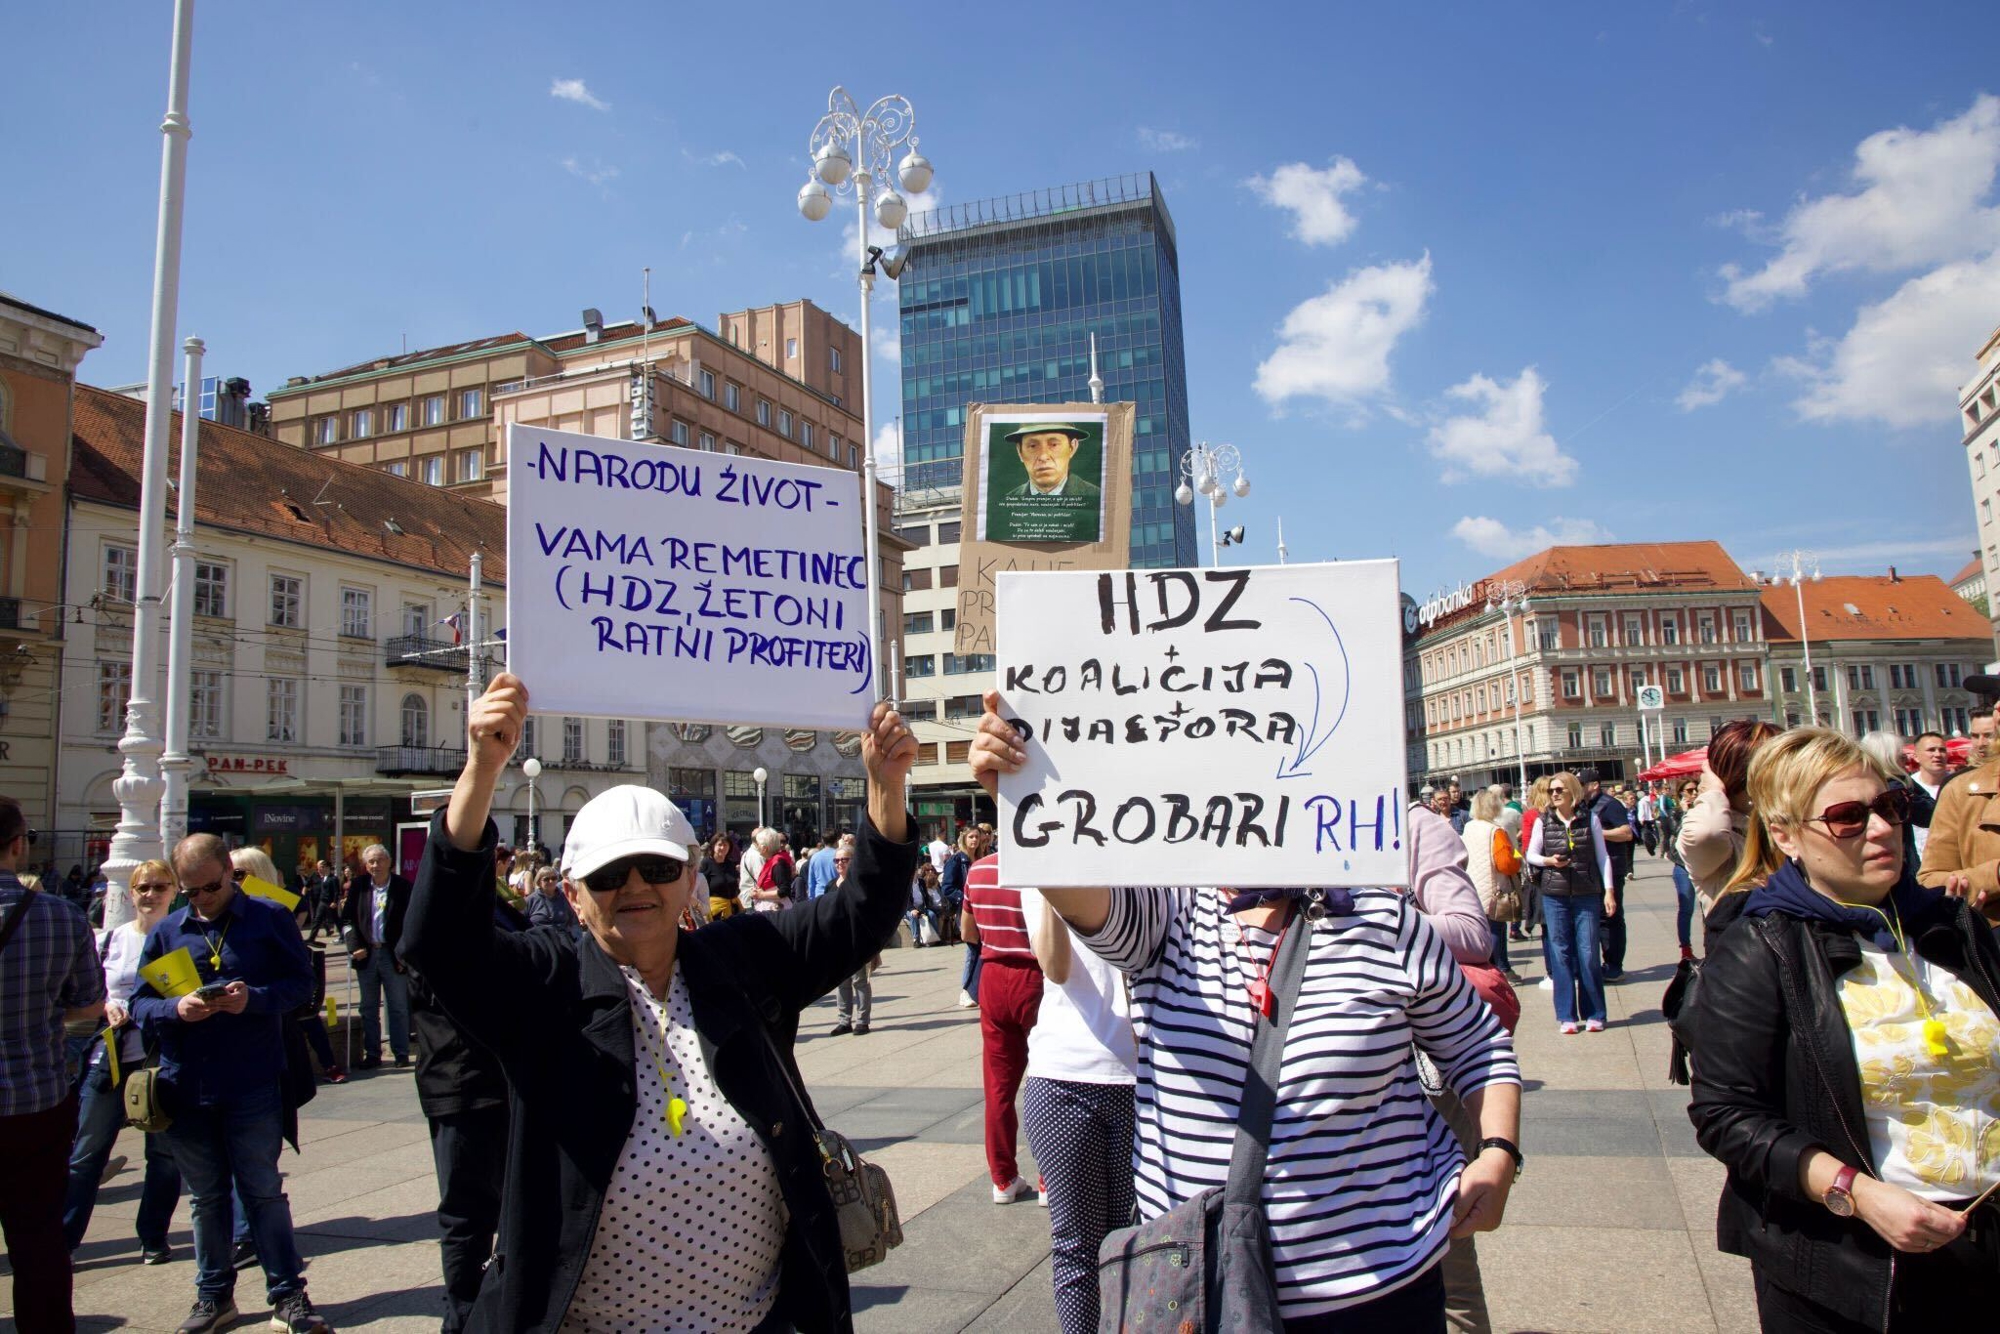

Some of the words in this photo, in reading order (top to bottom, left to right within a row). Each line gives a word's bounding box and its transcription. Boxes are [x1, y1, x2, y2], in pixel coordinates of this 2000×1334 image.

[535, 523, 653, 566] VAMA
[661, 537, 867, 590] REMETINEC
[1096, 569, 1262, 635] HDZ
[590, 616, 713, 662] RATNI
[1006, 657, 1293, 695] KOALICIJA
[208, 758, 288, 772] PAN-PEK
[1012, 788, 1291, 849] GROBARI
[1304, 787, 1402, 854] RH!
